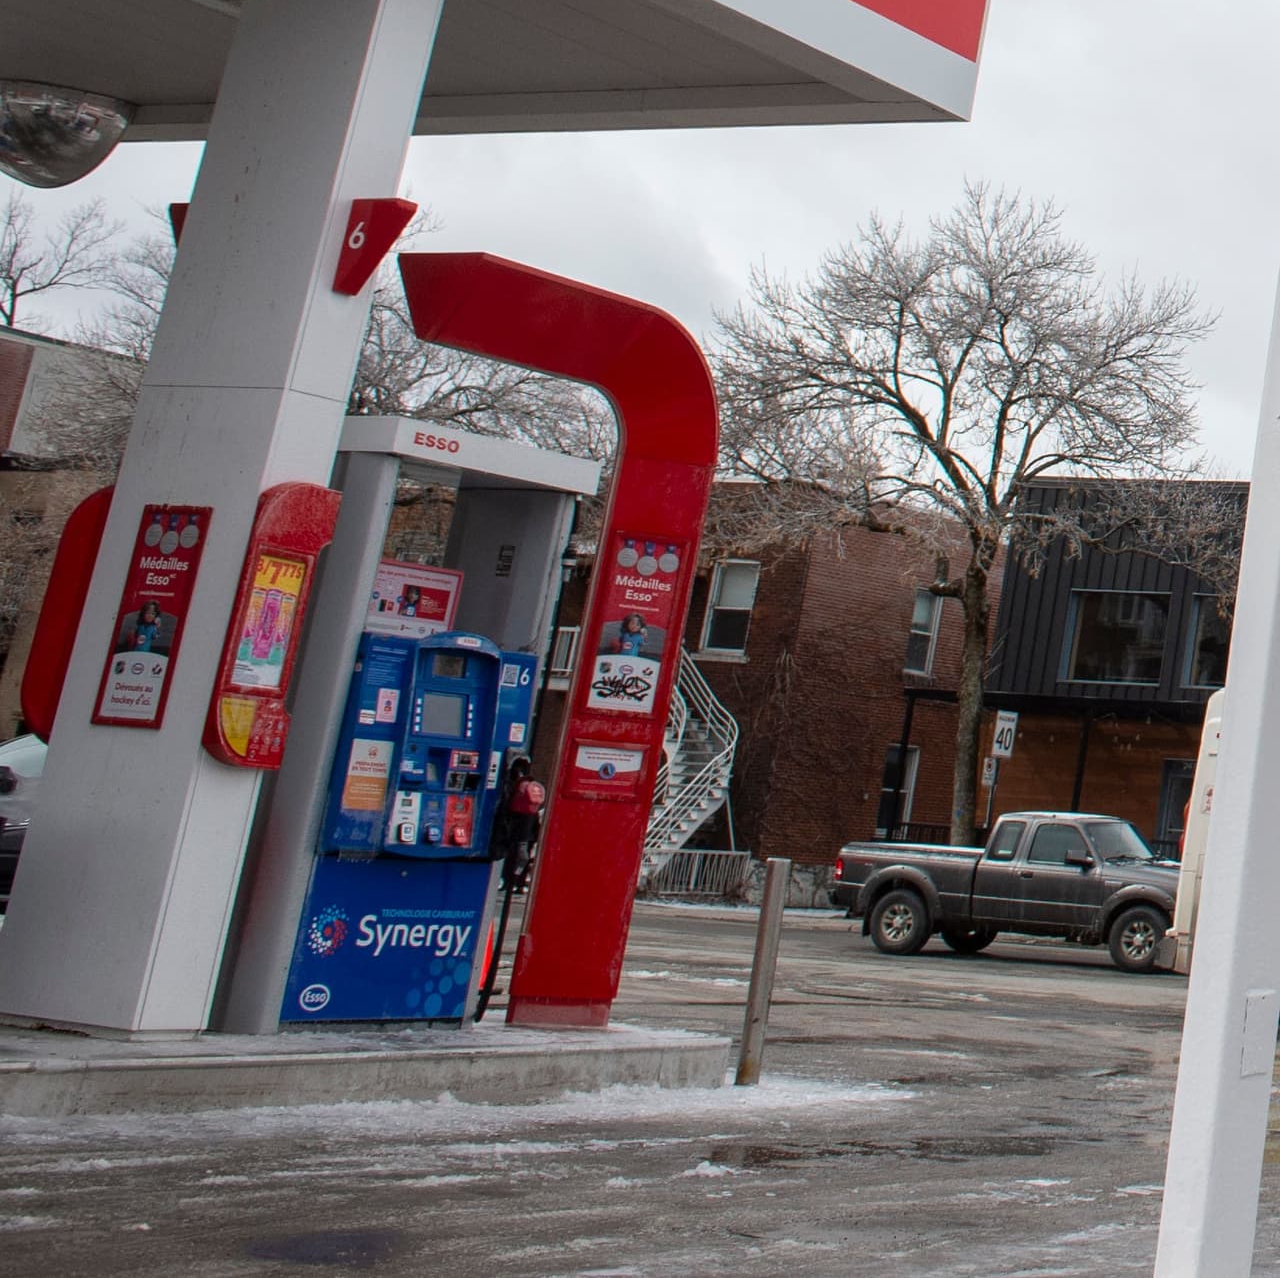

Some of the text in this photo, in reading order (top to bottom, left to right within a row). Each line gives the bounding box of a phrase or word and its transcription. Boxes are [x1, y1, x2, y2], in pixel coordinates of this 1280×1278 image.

[348, 221, 365, 249] 6
[413, 431, 460, 453] ESSO
[139, 556, 189, 572] Médailles
[615, 574, 672, 593] Médailles
[520, 667, 530, 686] 6
[995, 727, 1012, 750] 40
[381, 908, 477, 919] TECHNOLOGIE CARBURANT
[355, 914, 472, 957] Synergy
